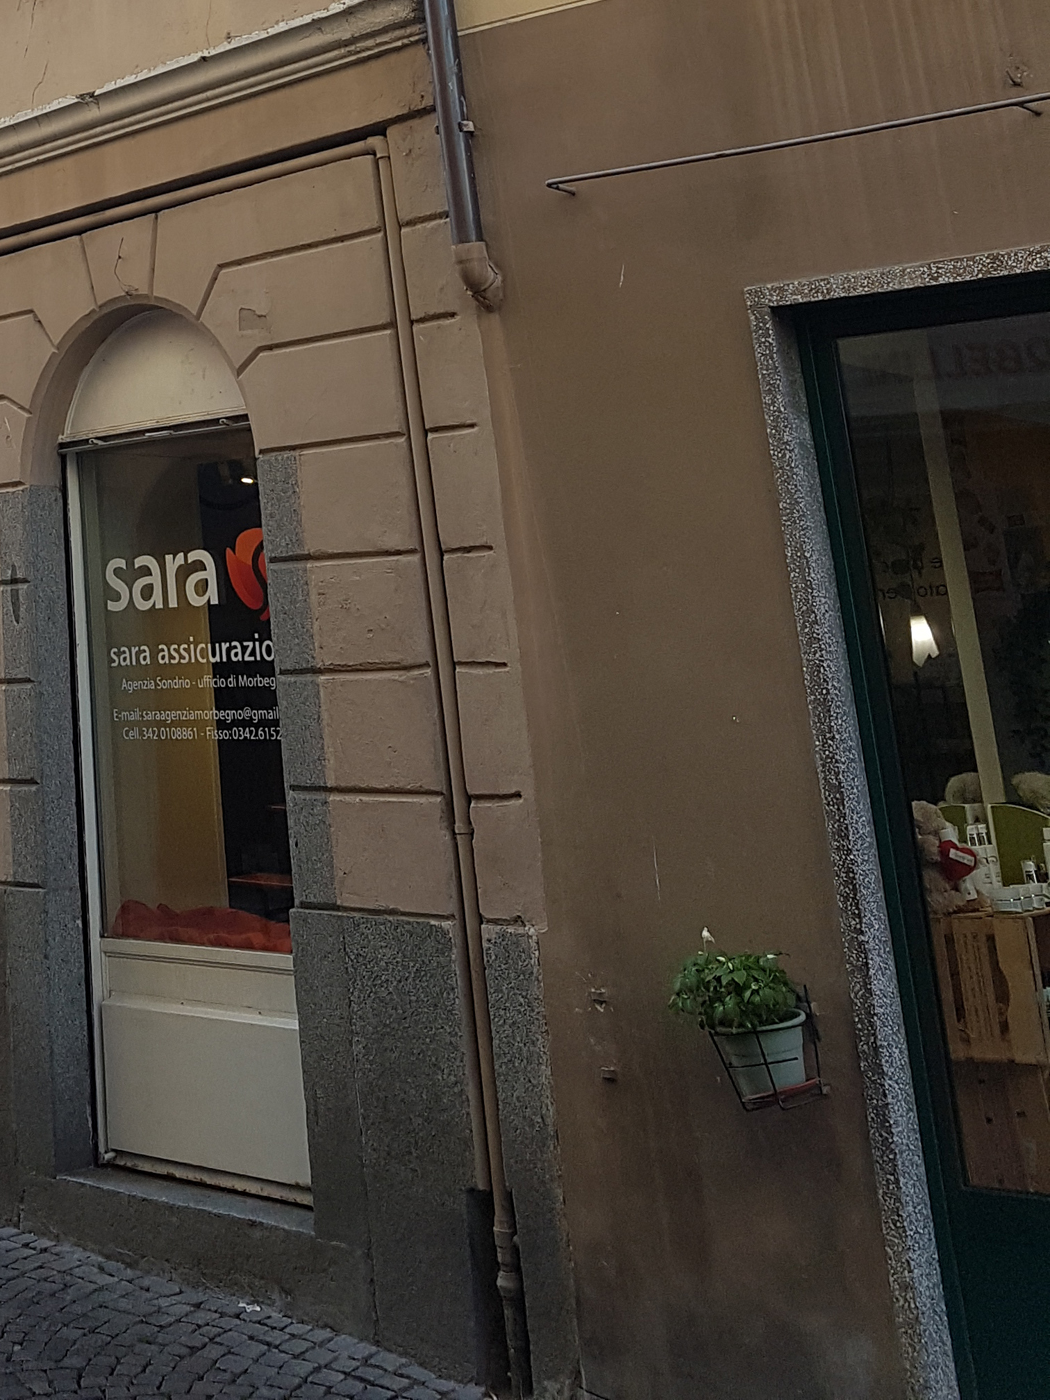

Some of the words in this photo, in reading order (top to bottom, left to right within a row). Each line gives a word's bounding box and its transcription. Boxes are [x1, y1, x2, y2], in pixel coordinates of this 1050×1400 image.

[105, 549, 219, 612] sara
[110, 645, 151, 668] sara
[157, 632, 275, 665] assicurazio
[121, 677, 155, 694] Agenzia
[156, 675, 191, 690] Sondrio
[197, 674, 226, 689] ufficio
[227, 673, 237, 688] di
[238, 673, 277, 691] Morbeg
